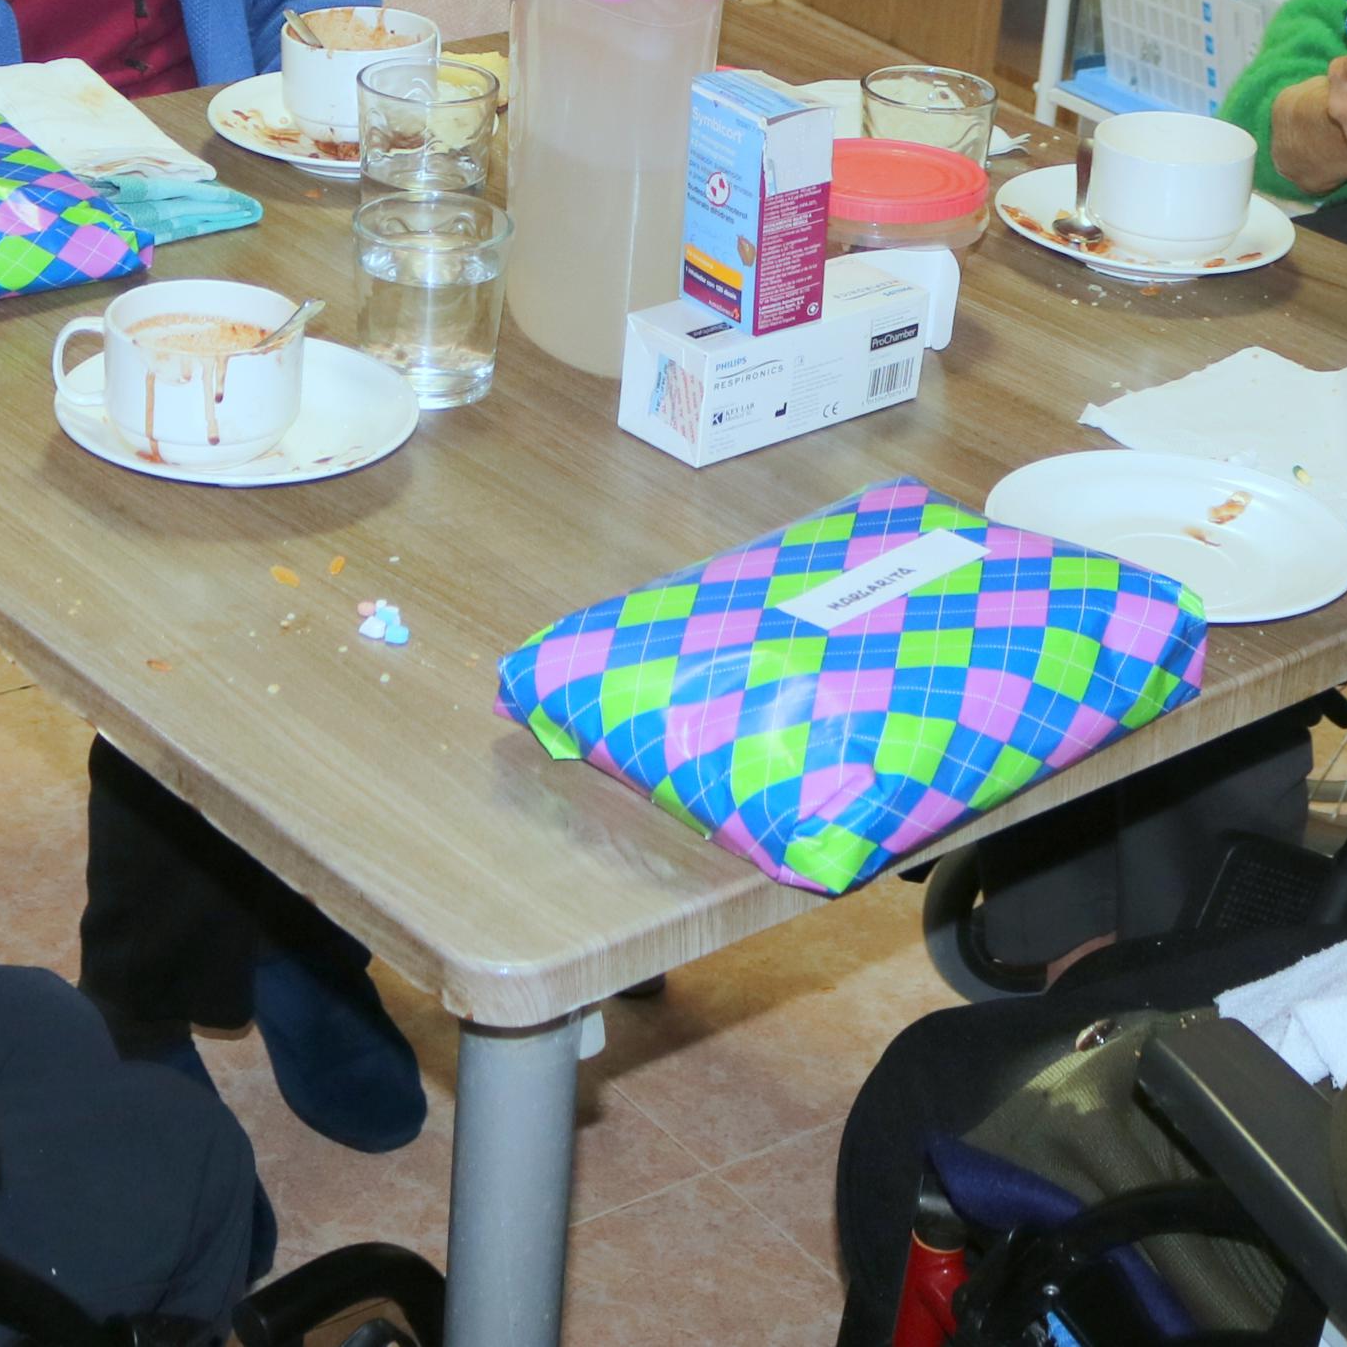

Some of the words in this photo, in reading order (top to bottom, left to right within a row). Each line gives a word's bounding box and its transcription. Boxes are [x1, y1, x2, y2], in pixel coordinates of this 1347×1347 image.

[691, 106, 743, 144] Symbicort
[871, 327, 918, 348] ProChamber
[713, 364, 784, 390] RESPIRONICS
[715, 356, 747, 372] PHILIPS
[827, 567, 917, 611] MARGARITA
